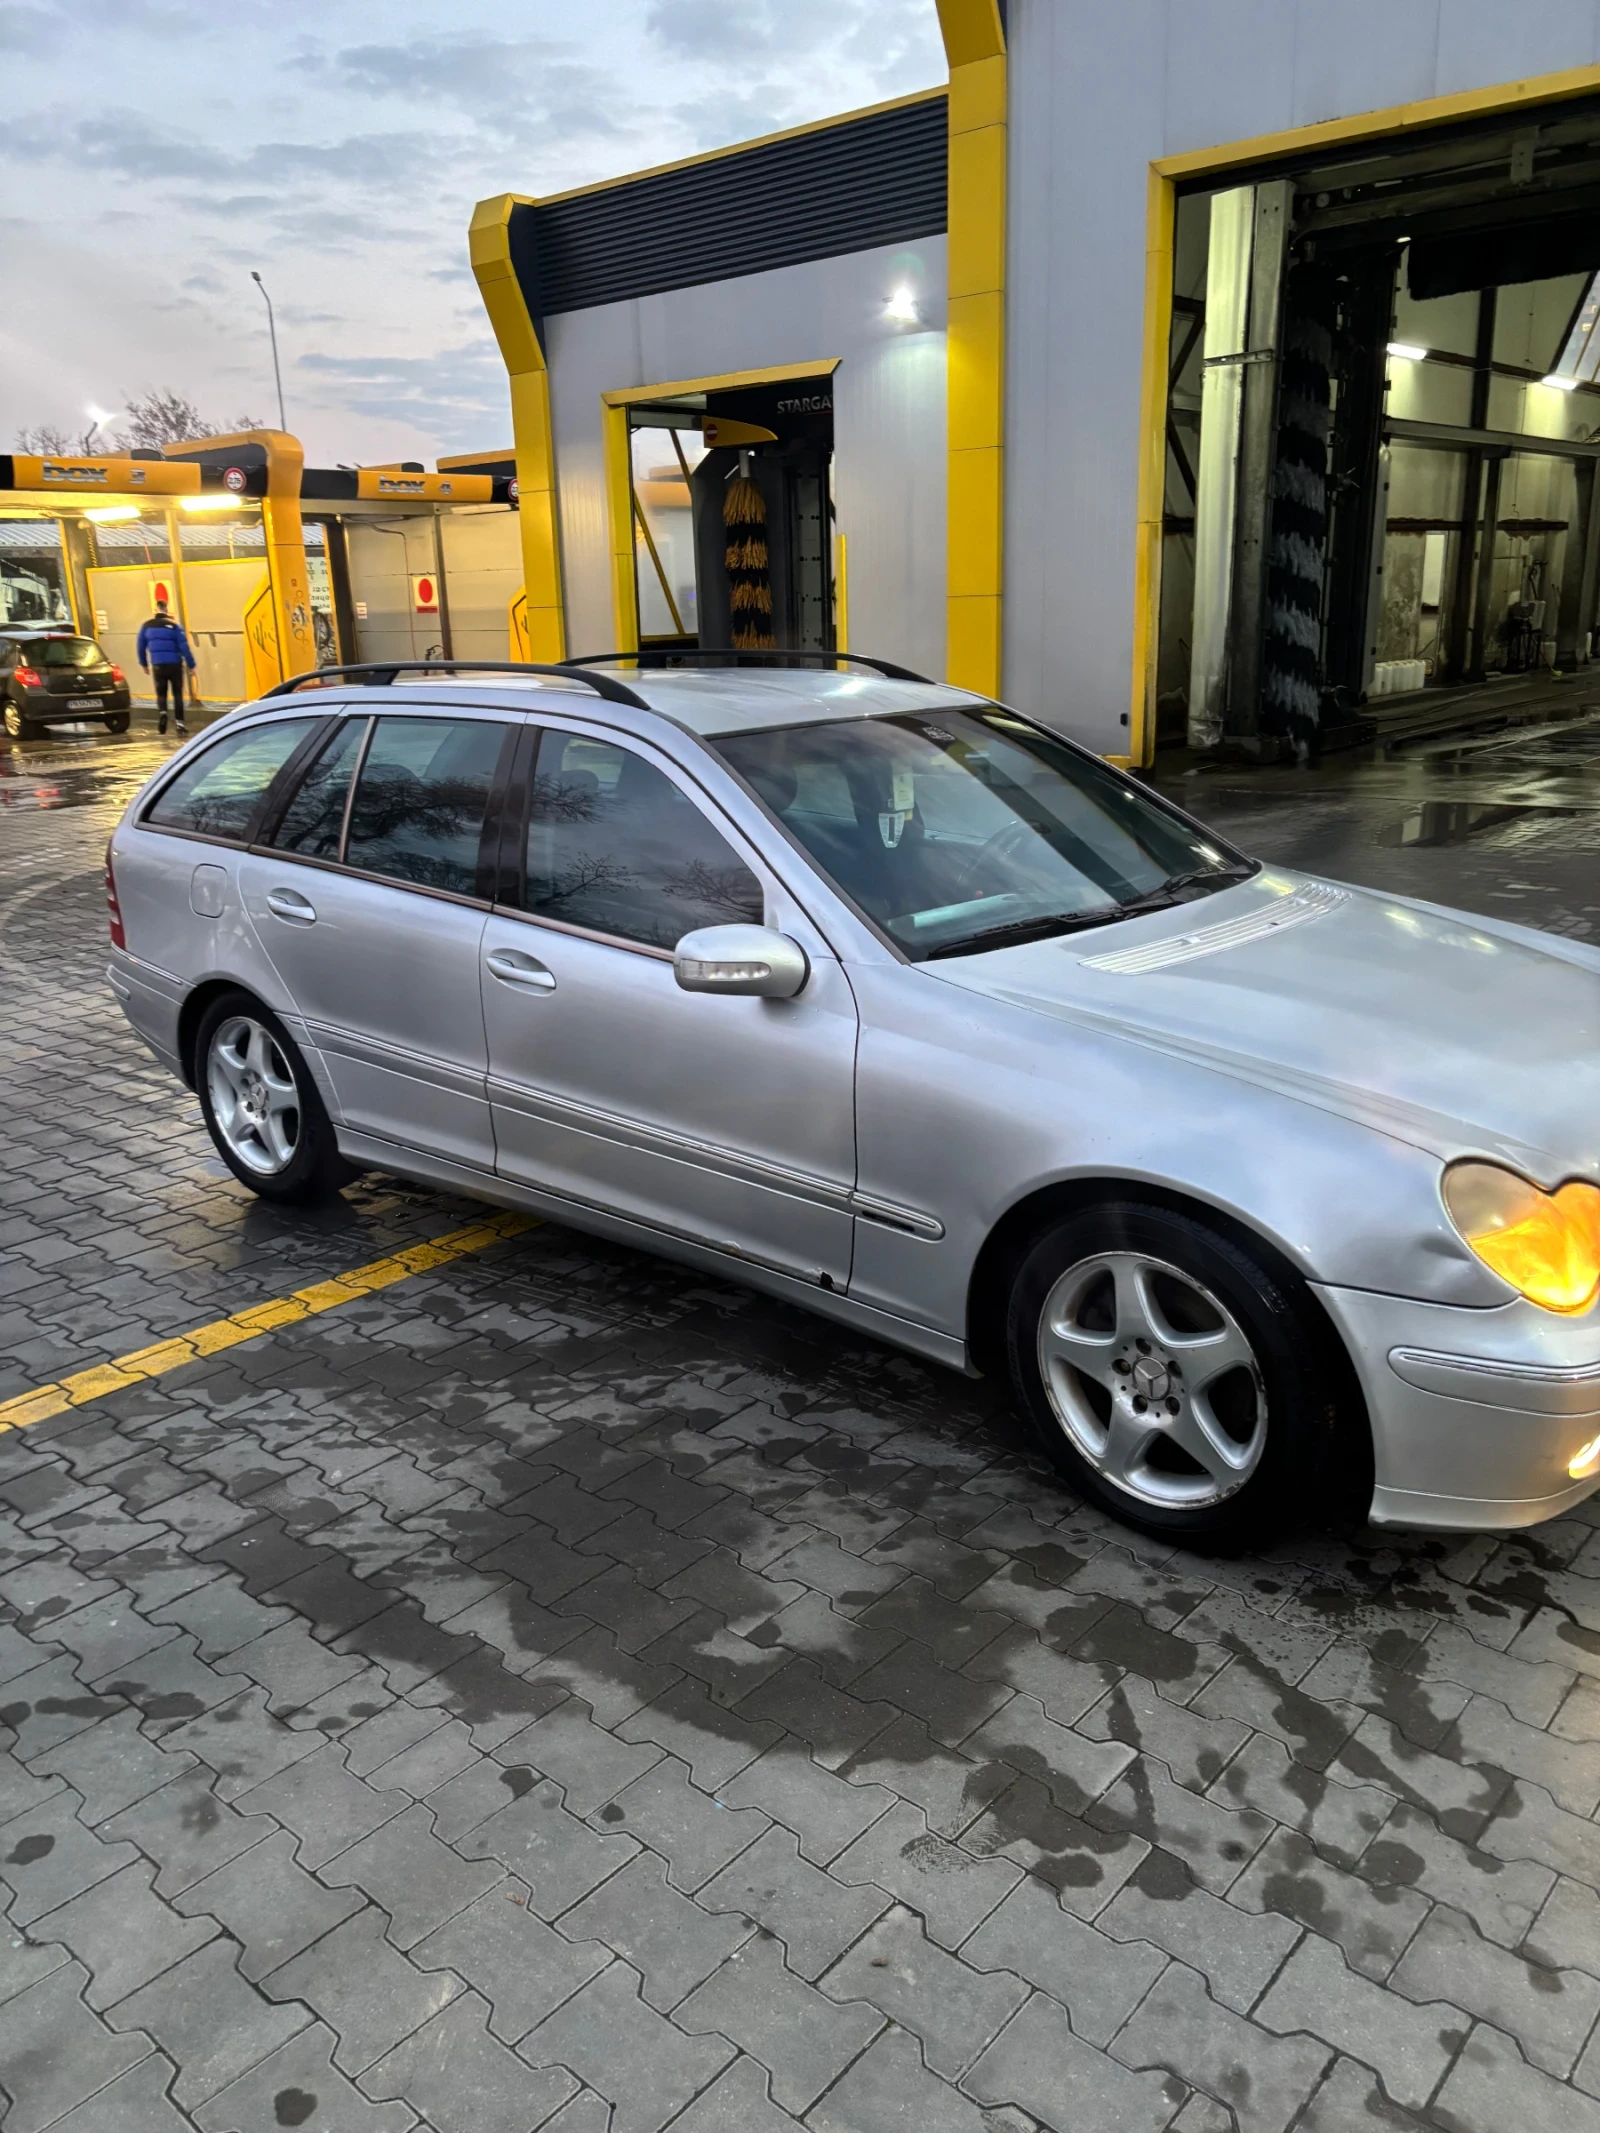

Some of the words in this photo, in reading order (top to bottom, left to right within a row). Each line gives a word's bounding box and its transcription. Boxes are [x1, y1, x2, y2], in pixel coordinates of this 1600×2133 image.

[777, 394, 832, 414] STARGA
[42, 460, 108, 483] box
[129, 468, 146, 484] 3
[379, 476, 426, 493] box
[440, 482, 452, 495] 4
